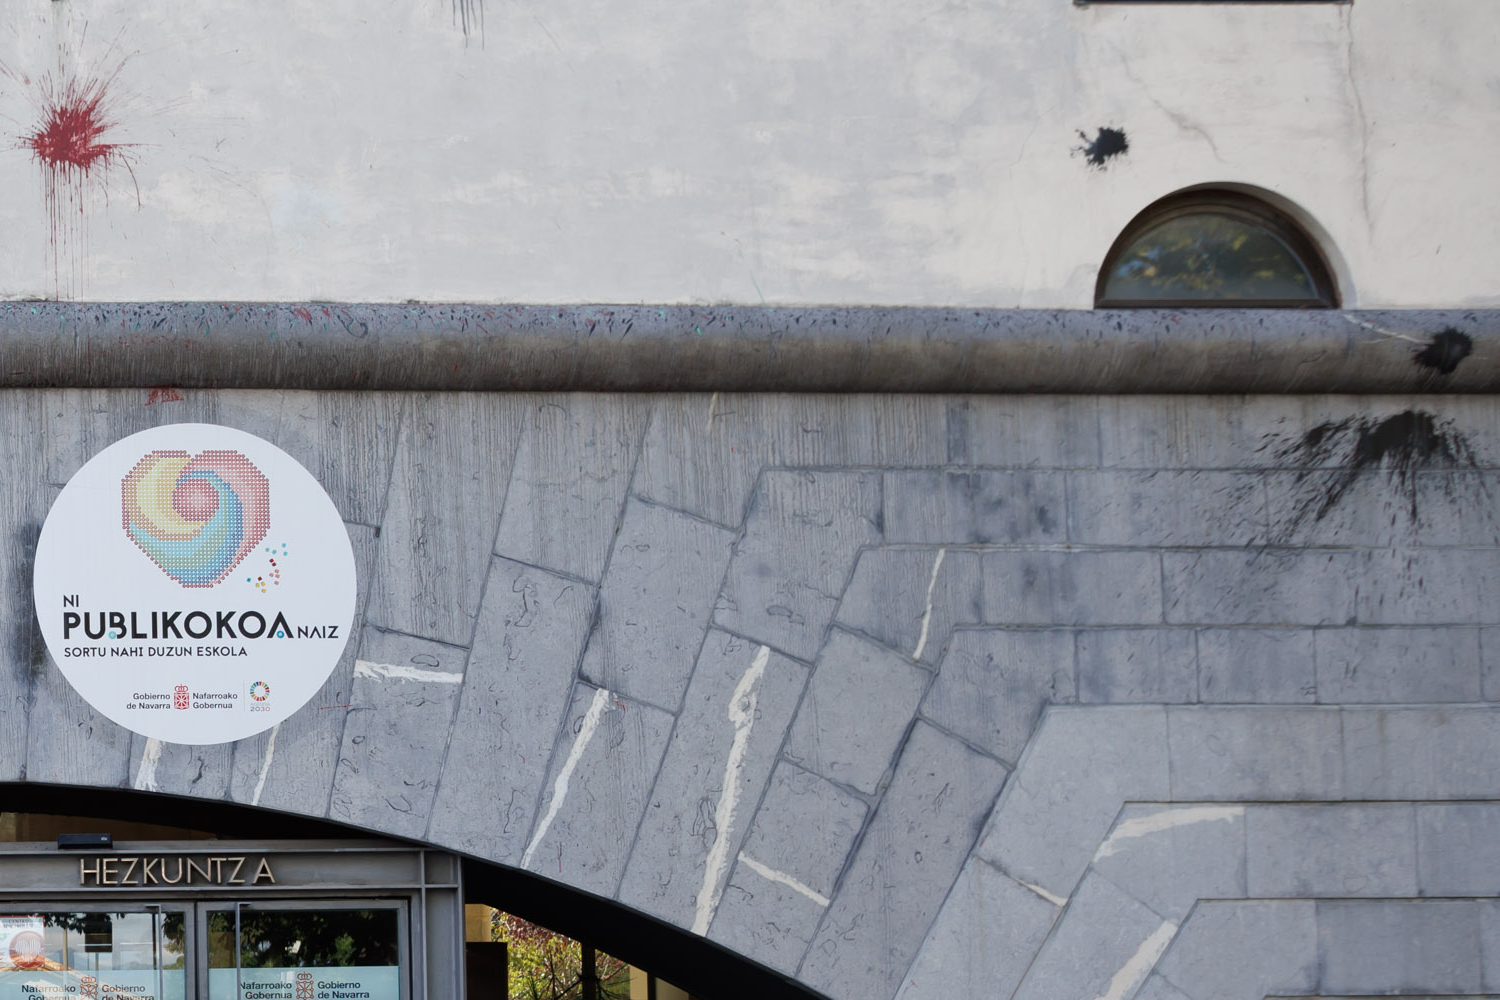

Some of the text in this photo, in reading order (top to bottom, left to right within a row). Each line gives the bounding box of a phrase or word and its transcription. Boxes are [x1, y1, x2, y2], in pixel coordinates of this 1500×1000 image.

[63, 594, 80, 608] NI
[63, 610, 339, 640] PUBLIKOKOA NAIZ
[64, 646, 248, 658] SORTU NAHI DUZUN ESKOLA
[133, 692, 171, 700] Gobierno
[192, 692, 238, 700] Nafarroako
[126, 702, 171, 710] de Navarra
[79, 856, 276, 886] HEZKUNTZA
[21, 984, 76, 994] Nafarroako
[101, 983, 146, 994] Gobierno
[240, 980, 293, 990] Nafarroako
[317, 980, 361, 990] Gobierno
[245, 991, 293, 1000] Gobernua
[317, 990, 370, 999] de Navarra
